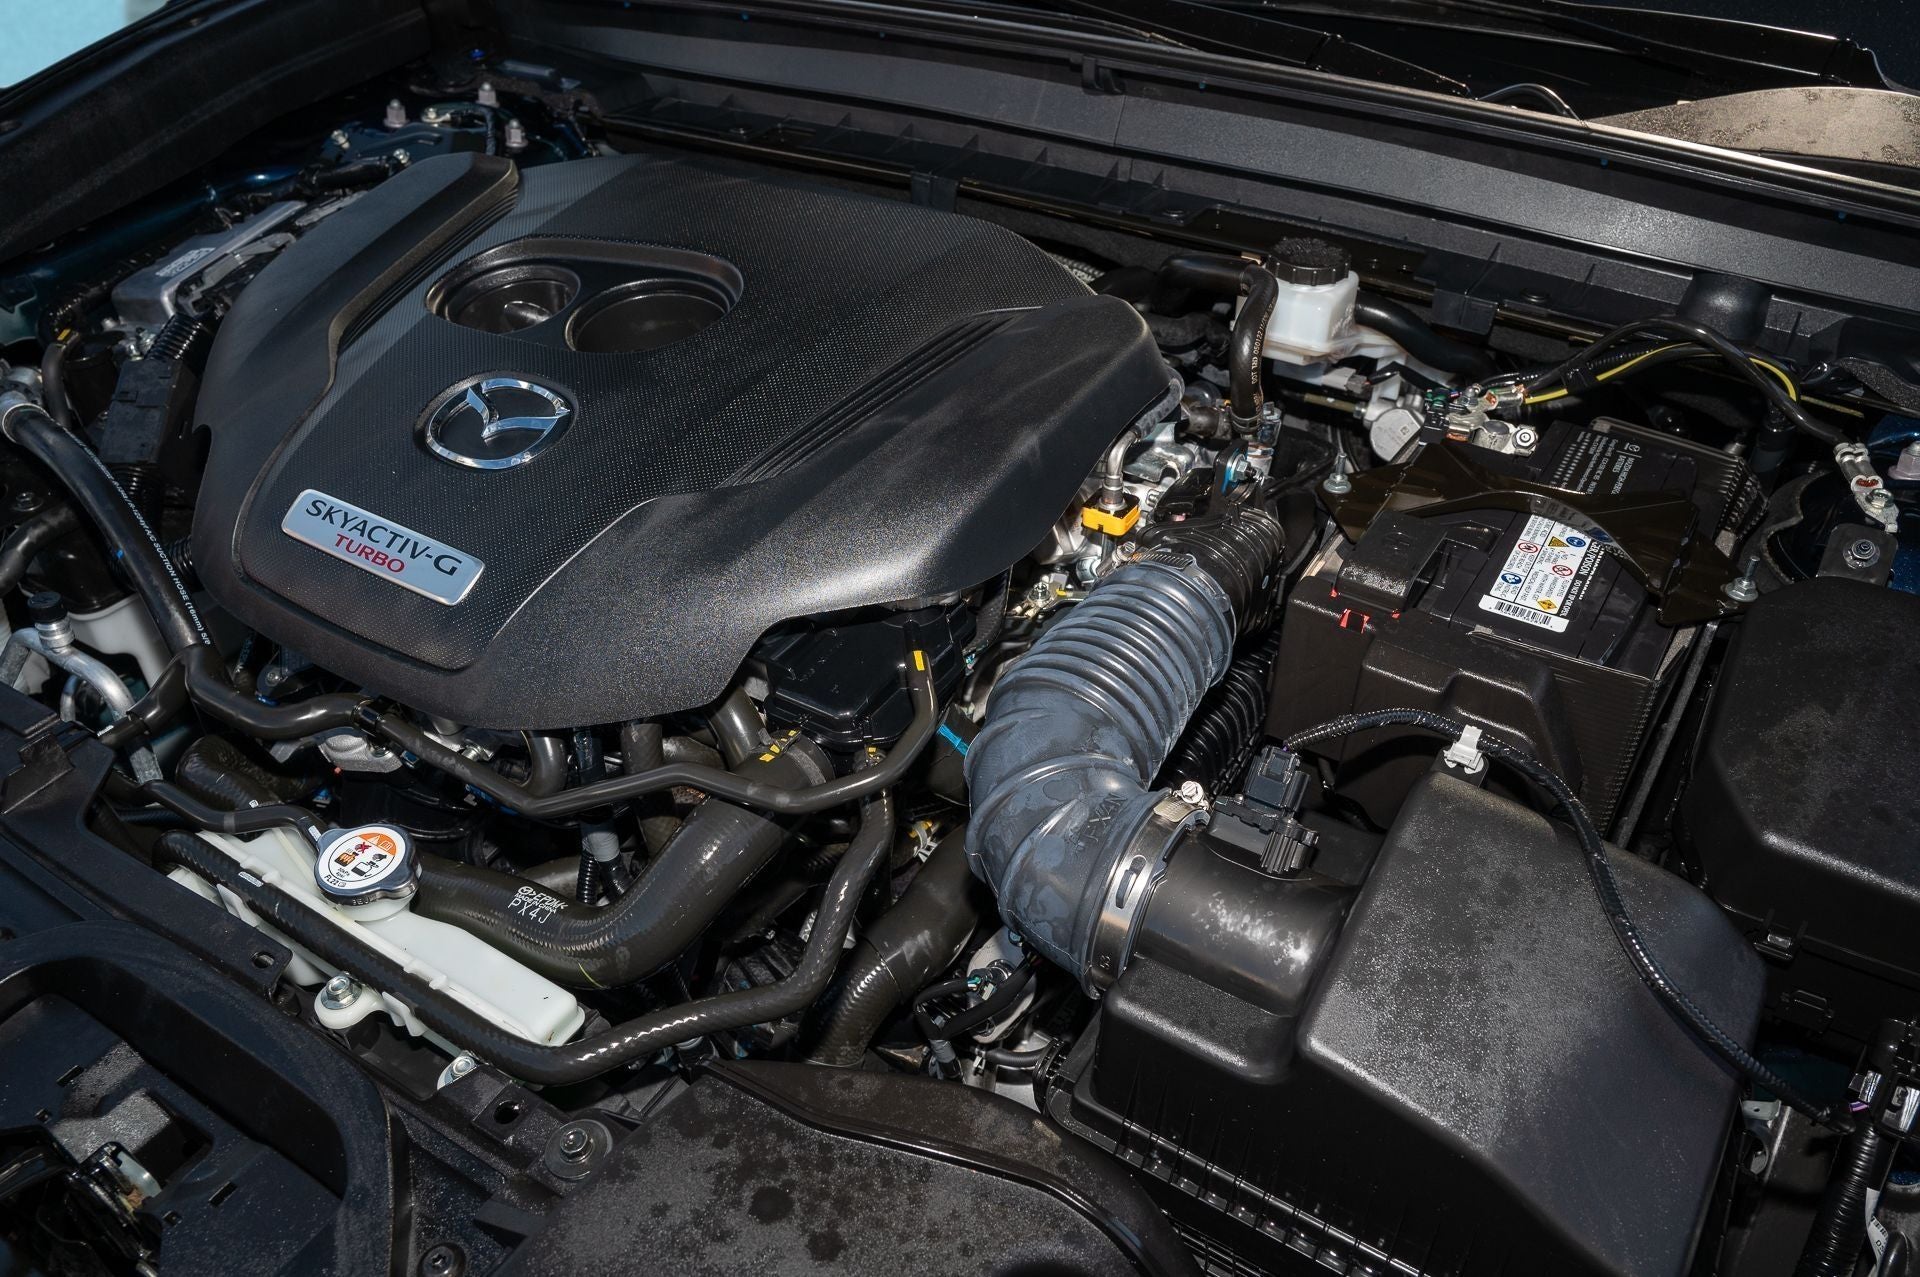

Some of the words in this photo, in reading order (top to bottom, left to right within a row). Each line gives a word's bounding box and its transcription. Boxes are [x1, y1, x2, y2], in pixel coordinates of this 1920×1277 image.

[306, 500, 462, 576] SKYACTIV-G
[335, 533, 405, 573] TURBO
[153, 541, 176, 577] SUCTION
[173, 577, 189, 601] HOSE
[185, 602, 204, 631] (16mm)
[507, 897, 552, 924] PX4J
